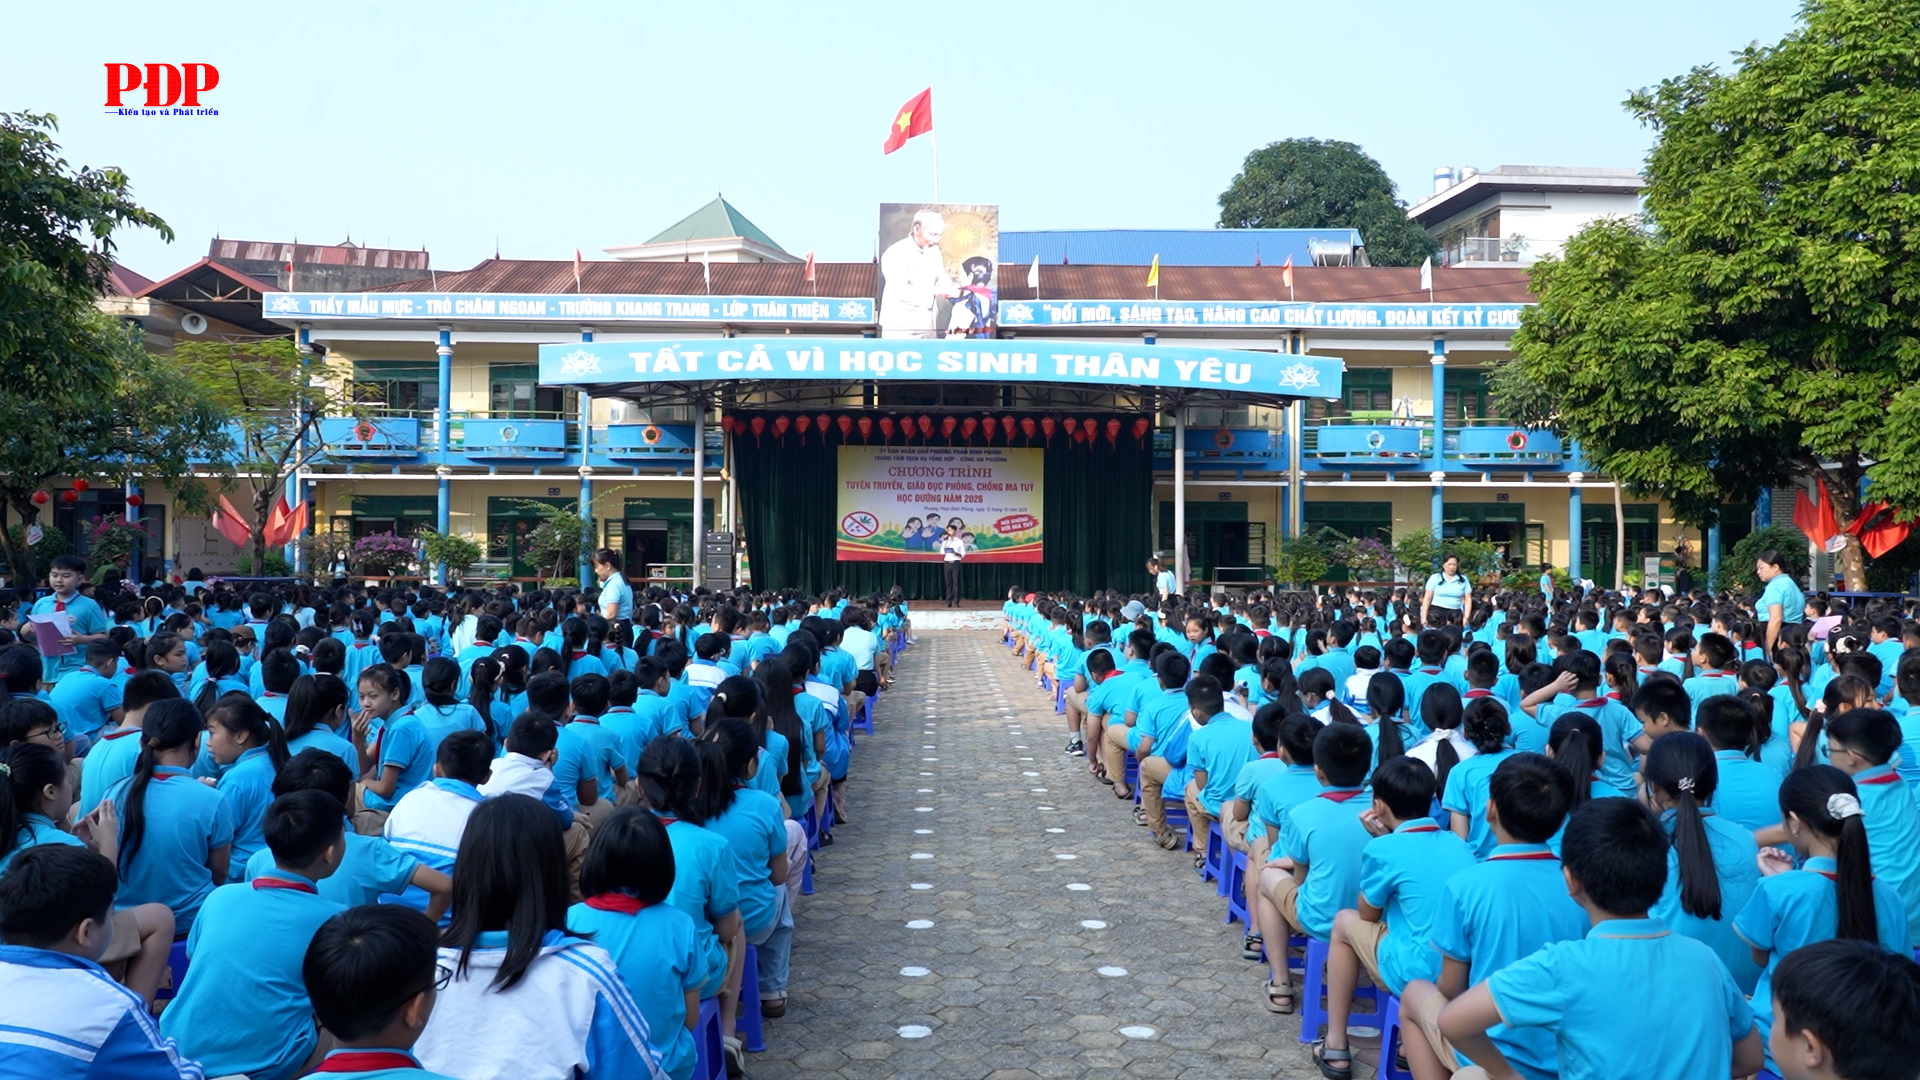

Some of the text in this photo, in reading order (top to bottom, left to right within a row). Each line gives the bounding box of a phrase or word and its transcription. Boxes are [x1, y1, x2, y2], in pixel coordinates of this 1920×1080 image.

[309, 297, 344, 314] THẦY
[347, 296, 379, 314] MẪU
[381, 299, 413, 316] MỰC
[425, 298, 451, 314] TRÒ
[455, 298, 497, 315] CHĂM
[499, 302, 546, 315] NGOAN
[559, 297, 612, 315] TRƯỜNG
[615, 301, 663, 316] KHANG
[666, 302, 711, 317] TRANG
[723, 299, 748, 317] LỚP
[751, 300, 787, 318] THÂN
[790, 303, 830, 321] THIỆN
[1081, 303, 1115, 322] MỚI,
[1120, 303, 1162, 321] SÁNG
[1165, 307, 1199, 325] TẠO,
[1202, 305, 1245, 322] NÂNG
[1250, 308, 1281, 322] CAO
[1284, 306, 1324, 324] CHẤT
[1327, 308, 1382, 327] LƯỢNG,
[1385, 307, 1428, 325] ĐOÀN
[1432, 306, 1459, 325] KẾT
[629, 343, 1252, 384] TẤT CẢ VÌ HỌC SINH THÂN YÊU
[889, 466, 992, 478] CHƯƠNG TRÌNH
[907, 481, 926, 490] GIÁO
[928, 482, 943, 493] DỤC
[946, 481, 975, 492] PHÒNG,
[976, 481, 1003, 492] CHỐNG
[1005, 484, 1019, 492] MA
[897, 492, 983, 504] HỌC ĐƯỜNG NĂM 2026
